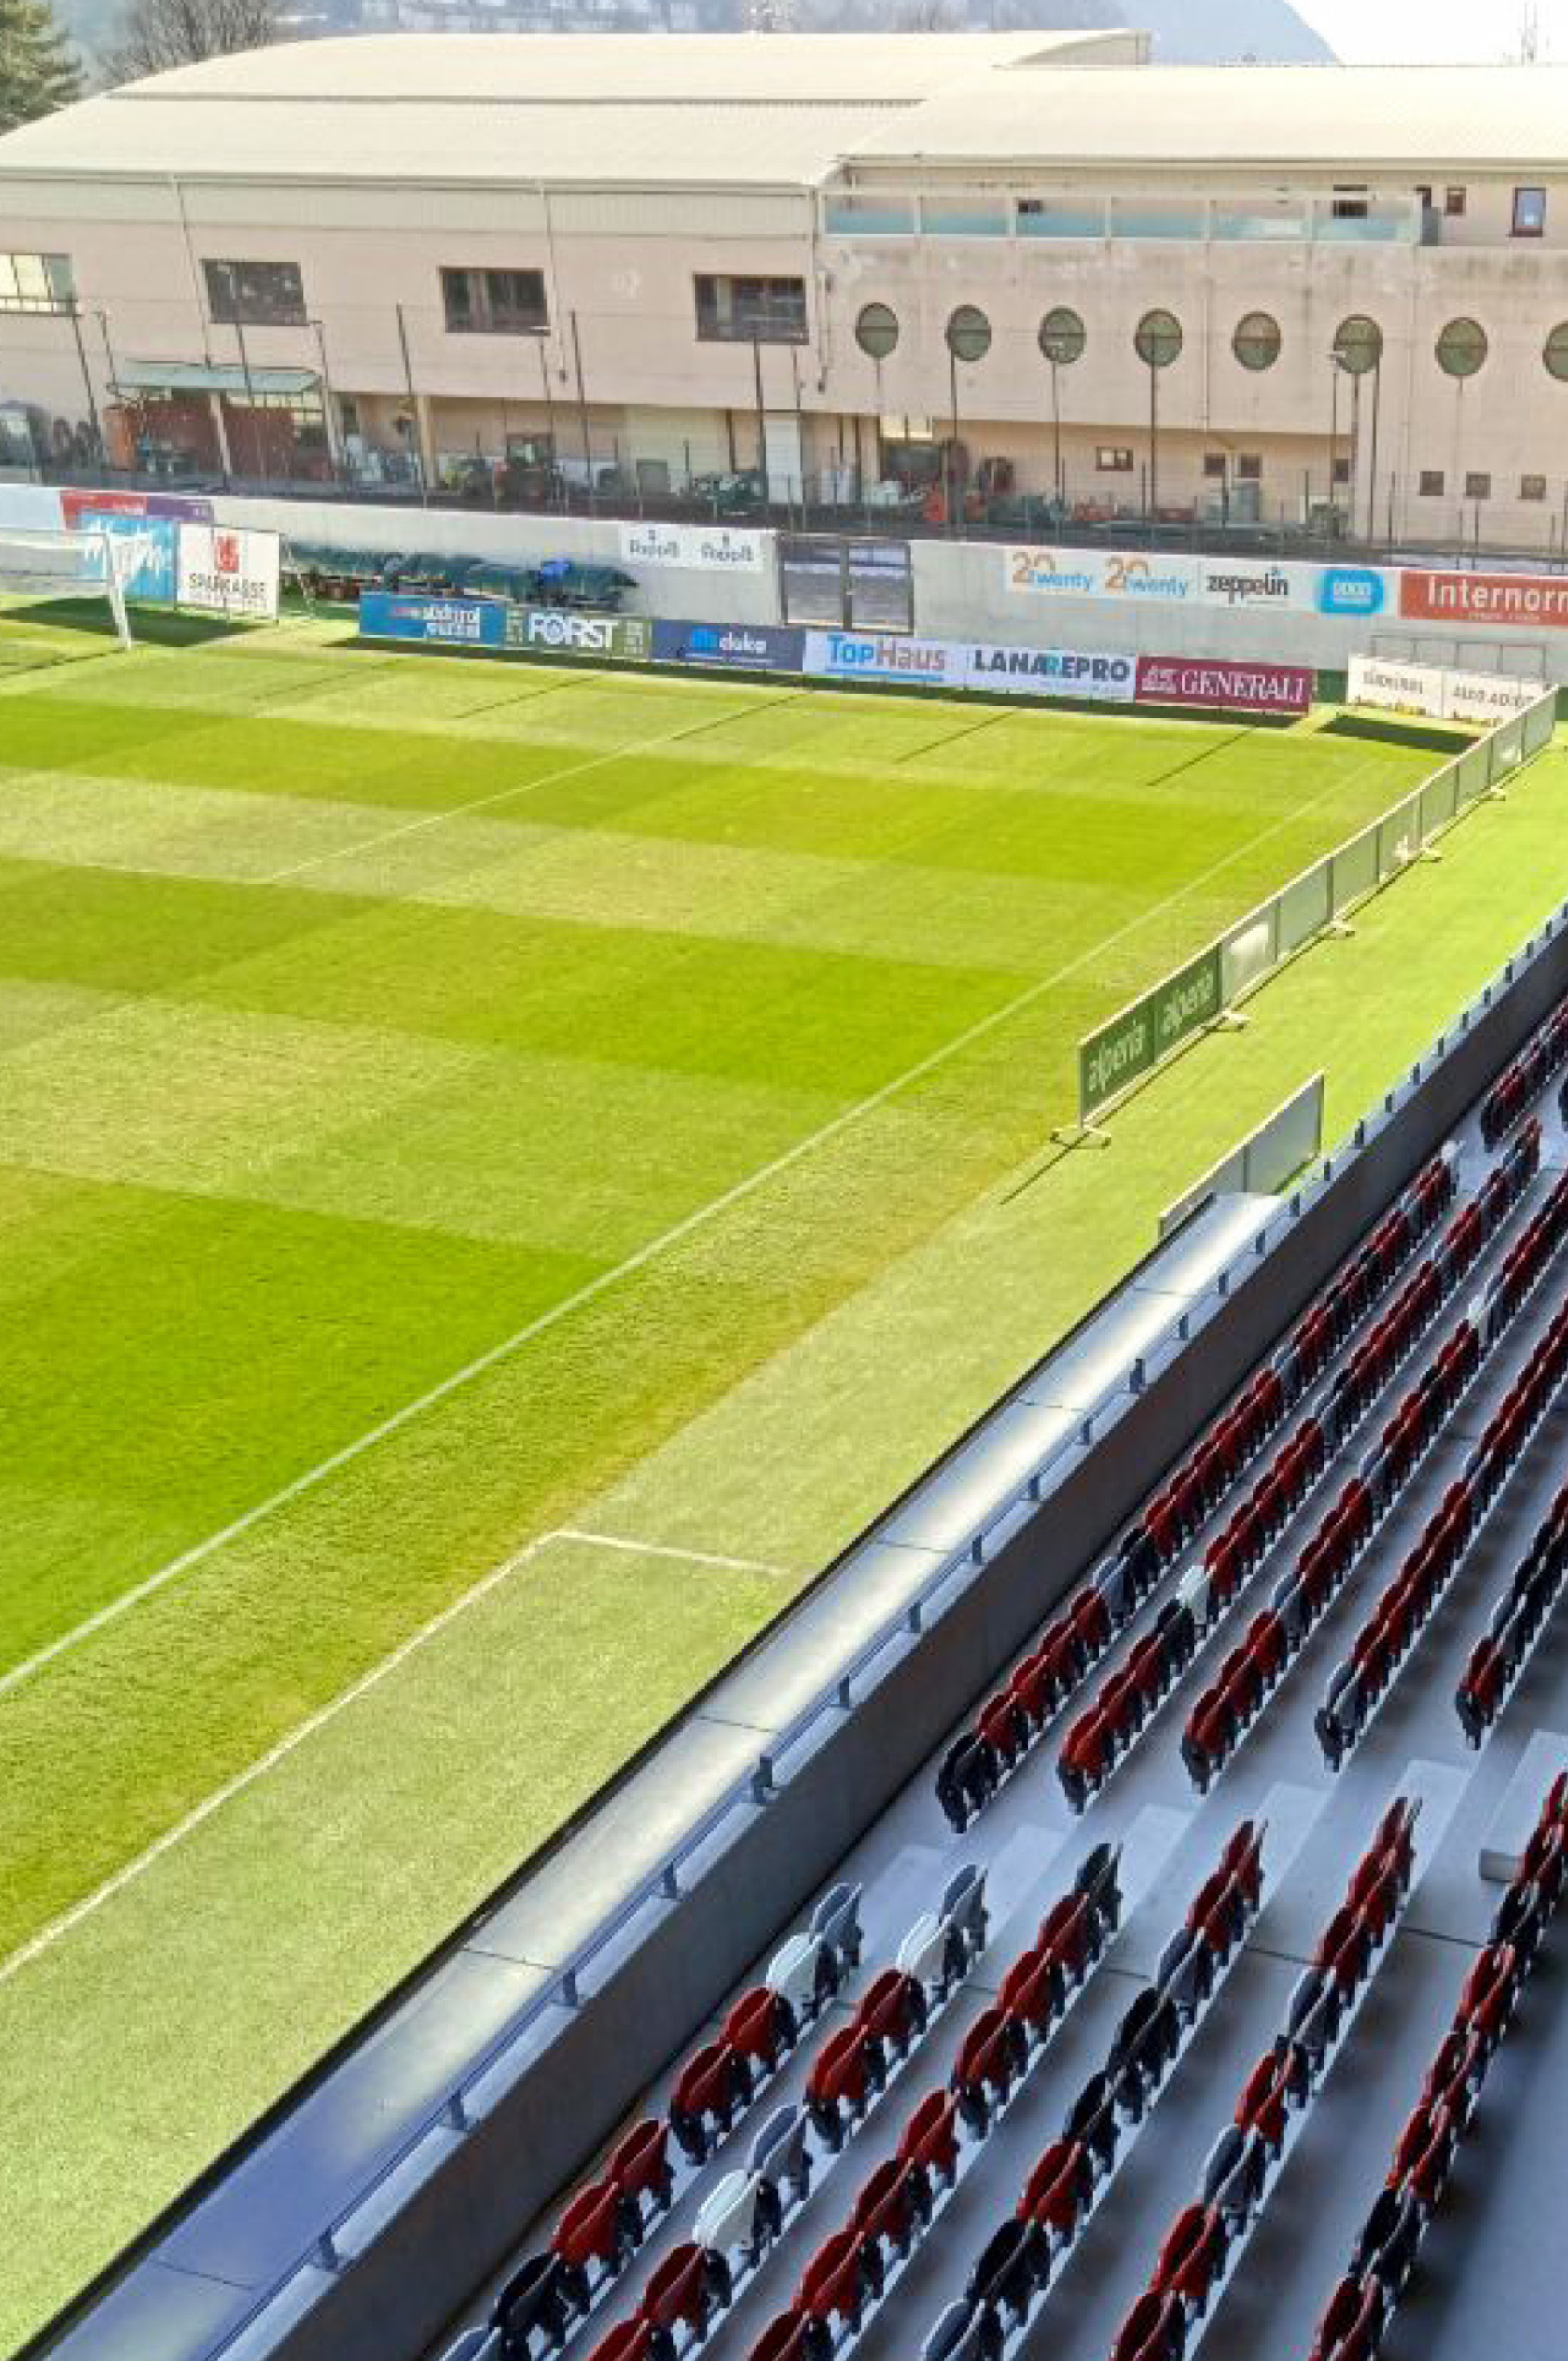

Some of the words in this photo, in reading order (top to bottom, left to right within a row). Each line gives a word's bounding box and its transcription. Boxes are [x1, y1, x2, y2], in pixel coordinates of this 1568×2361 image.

[1207, 567, 1289, 604] zeppelin
[528, 612, 619, 648] FORST
[827, 634, 946, 671] TopHaus
[975, 648, 1131, 682] LANAREPRO
[1181, 668, 1305, 703] GENERALI
